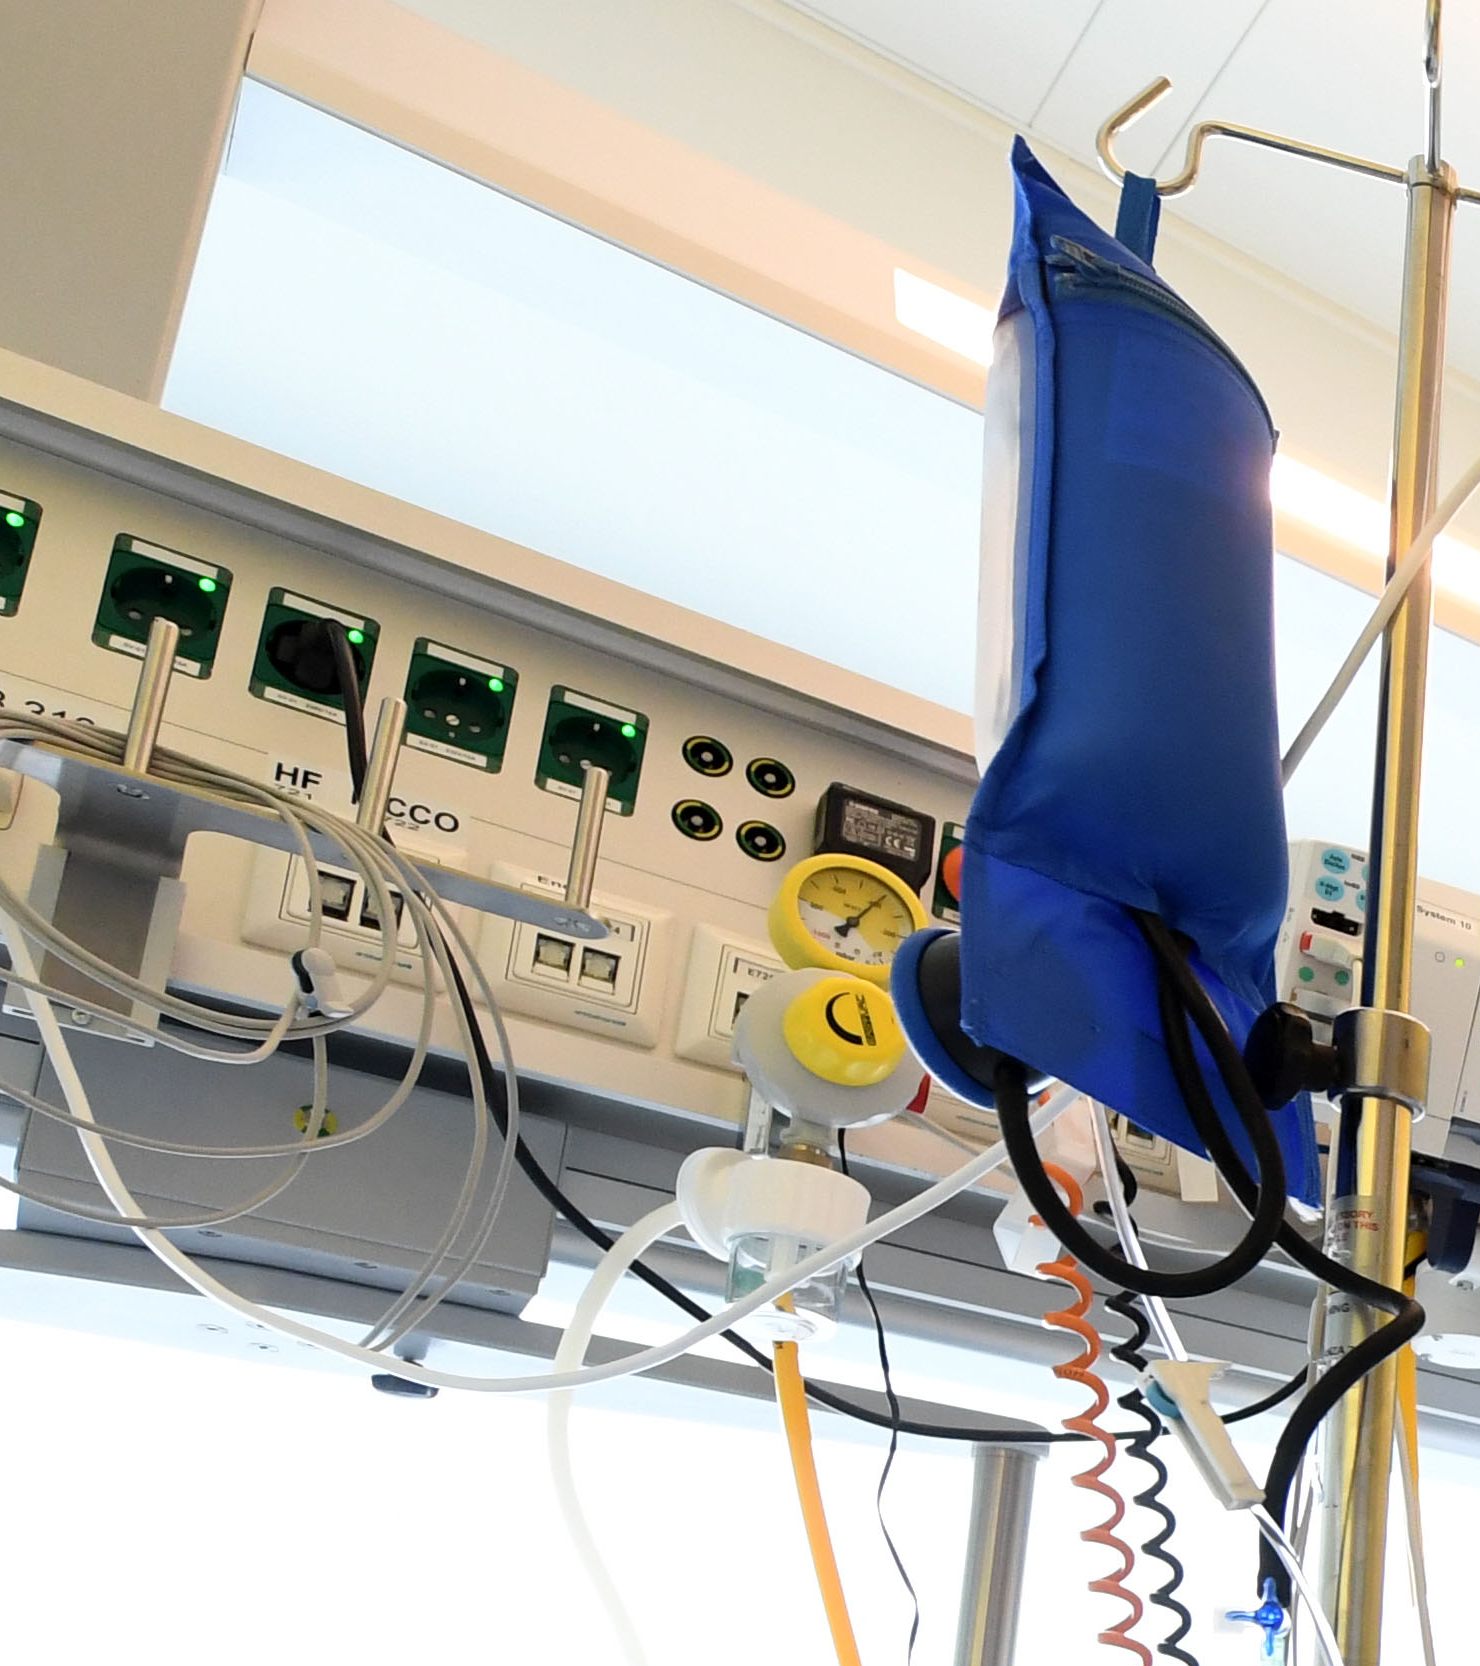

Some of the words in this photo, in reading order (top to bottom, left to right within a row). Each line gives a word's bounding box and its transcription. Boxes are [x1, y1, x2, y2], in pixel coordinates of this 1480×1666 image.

[274, 762, 323, 790] HF
[1415, 905, 1456, 926] System
[1460, 919, 1472, 931] 10
